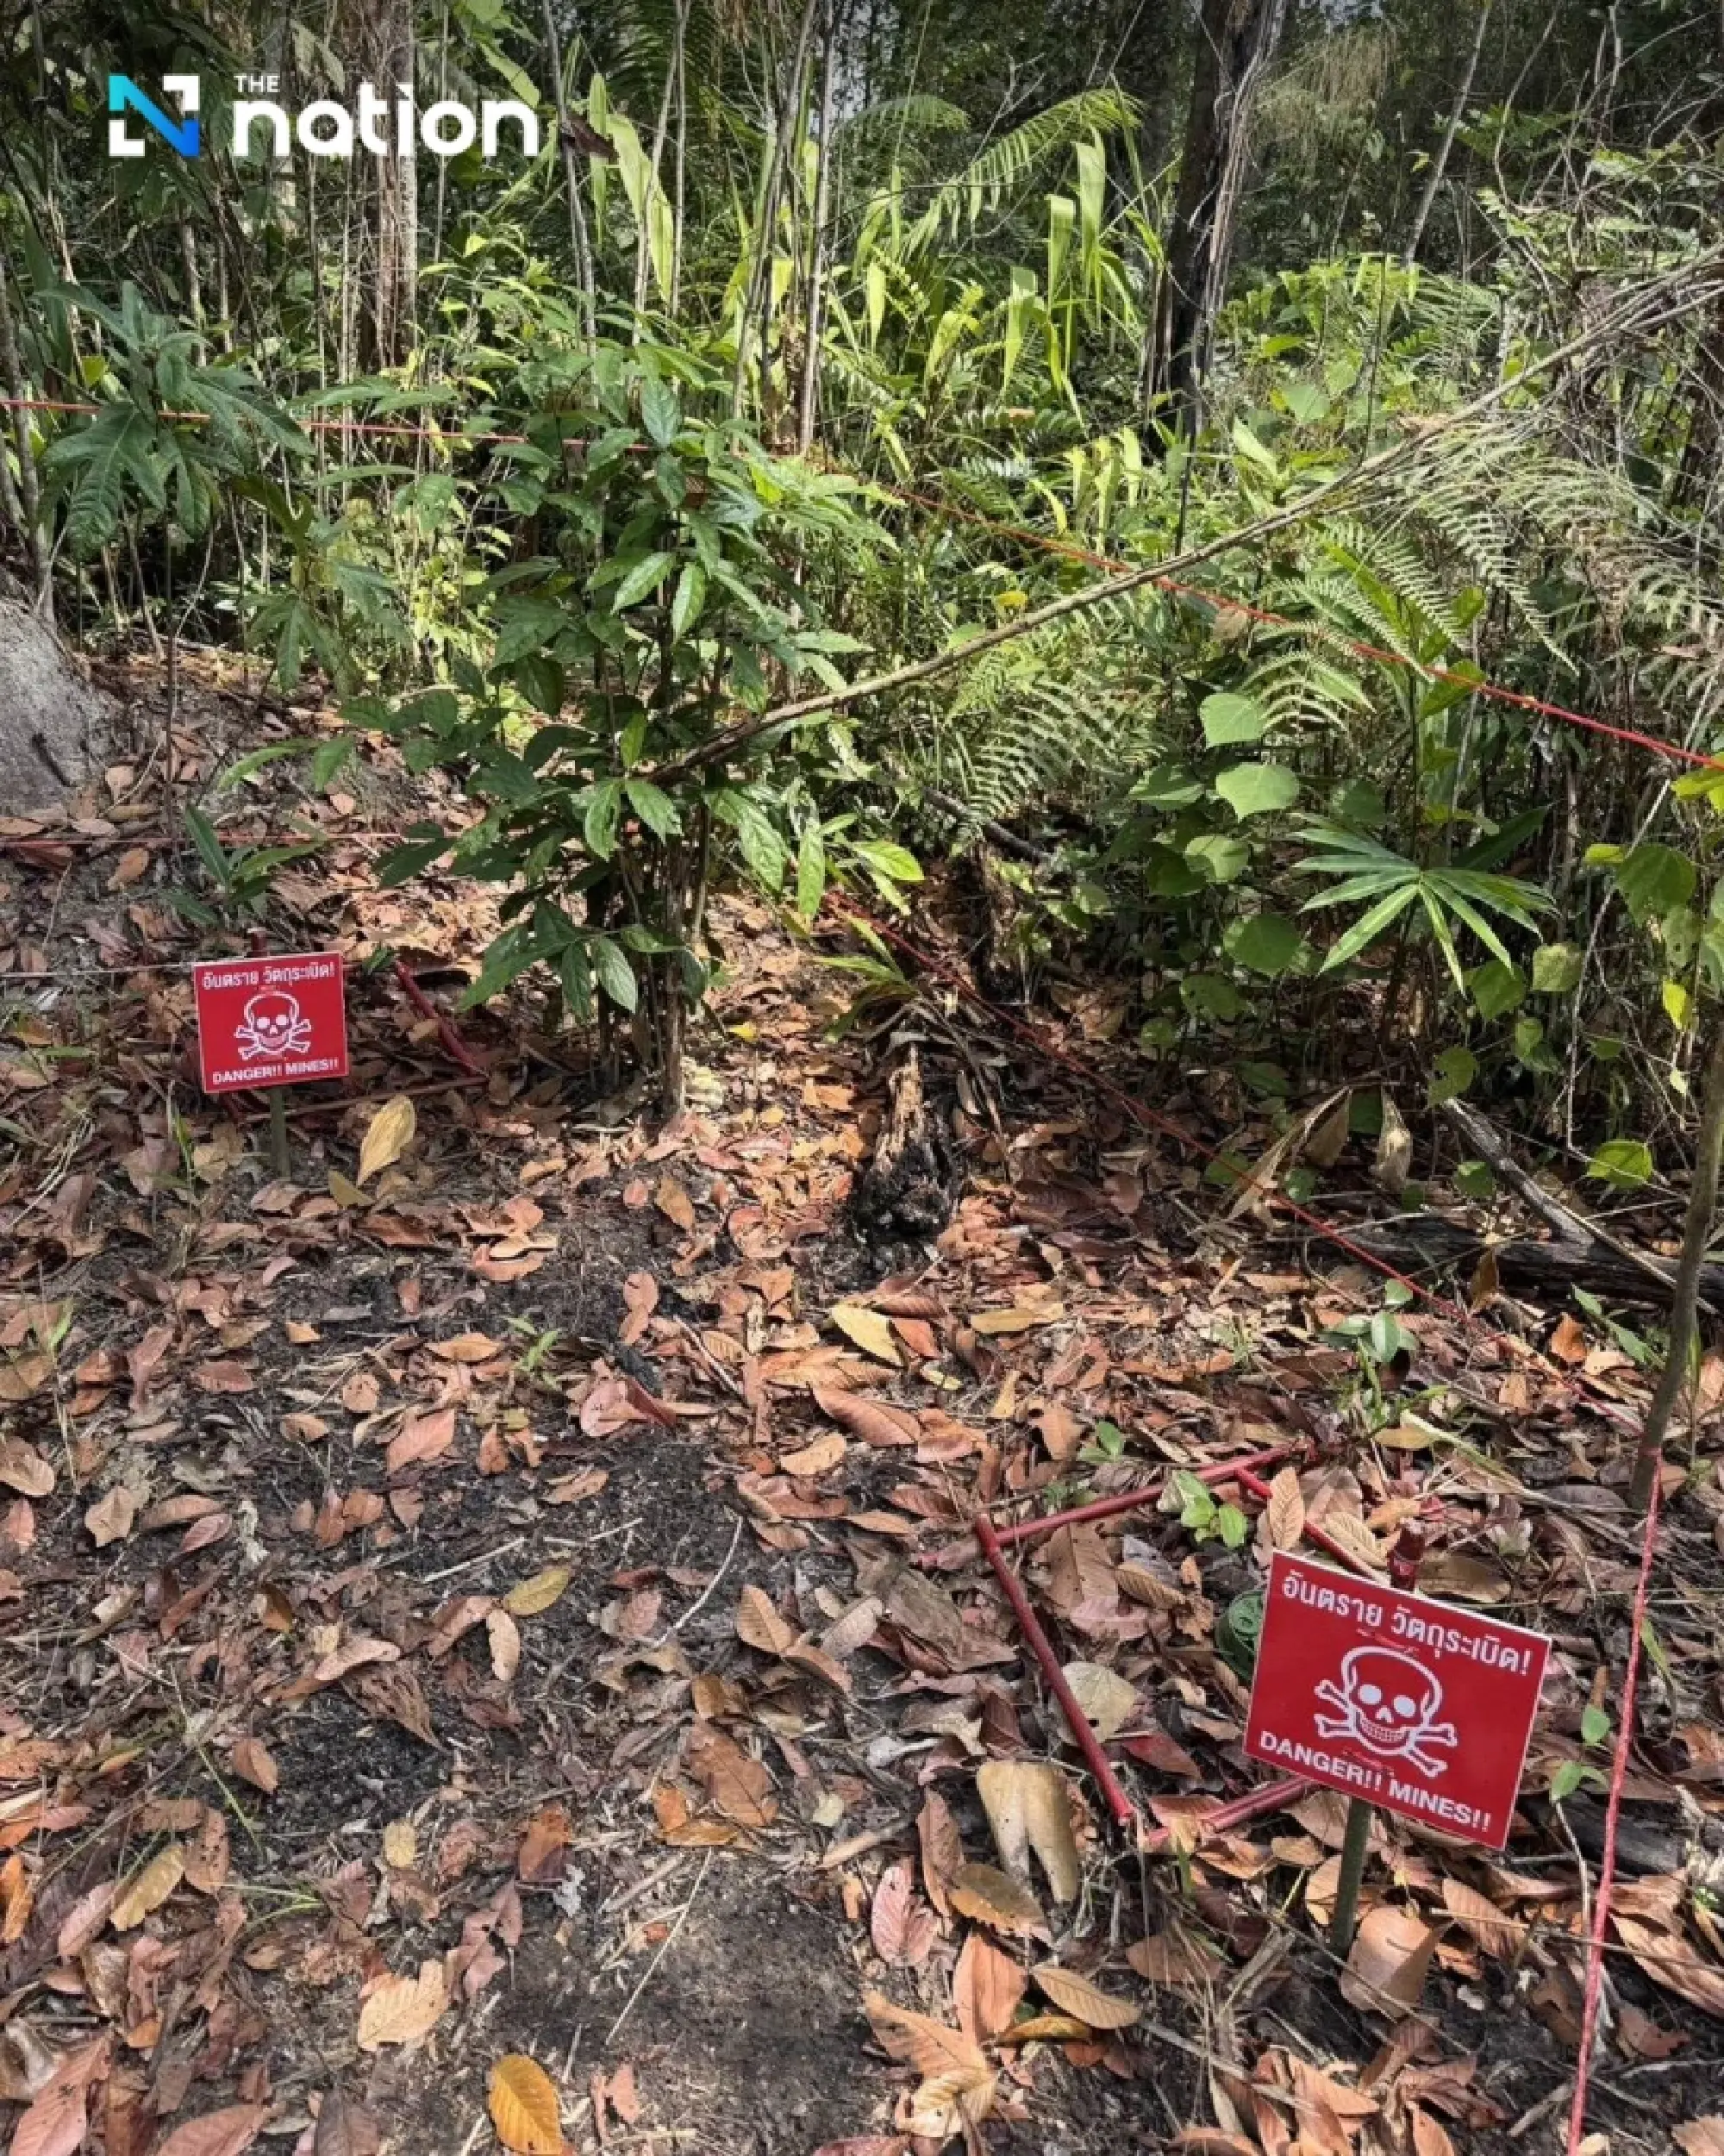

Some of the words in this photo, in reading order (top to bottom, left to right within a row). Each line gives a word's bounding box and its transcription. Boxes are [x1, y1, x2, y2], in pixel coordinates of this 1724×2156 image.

[212, 1063, 283, 1085] DANGER!!
[285, 1057, 339, 1075] MINES!!
[1282, 1569, 1384, 1628] อันตราย
[1259, 1730, 1382, 1792] DANGER!!
[1388, 1778, 1492, 1833] MINES!!
